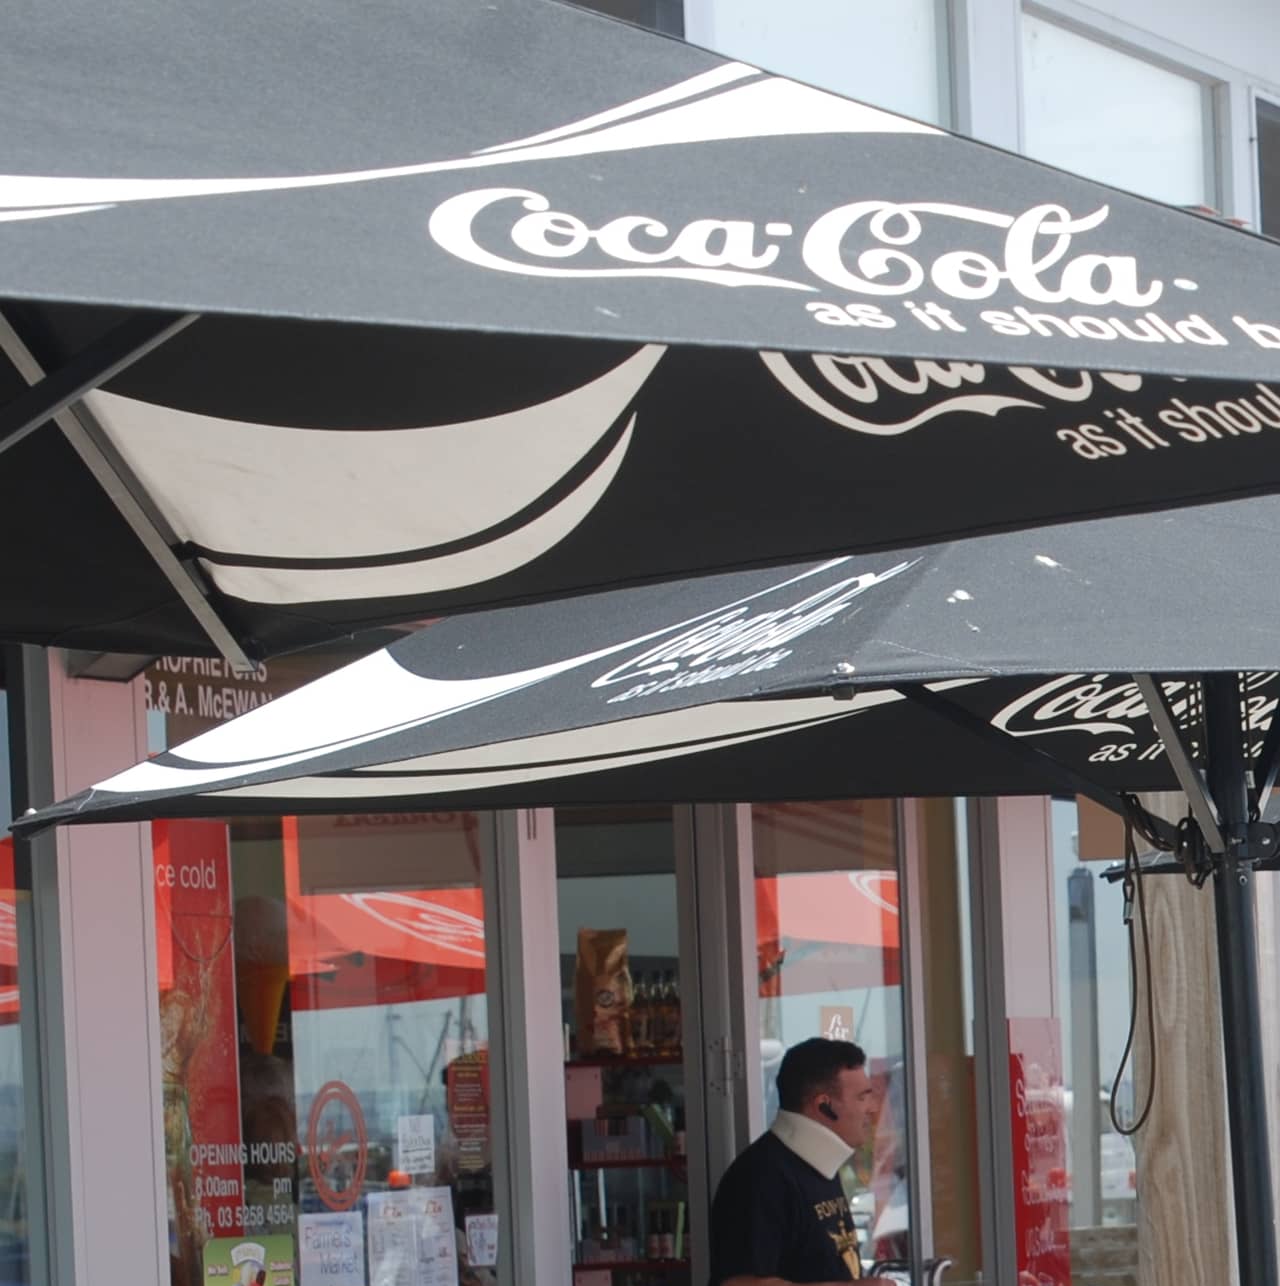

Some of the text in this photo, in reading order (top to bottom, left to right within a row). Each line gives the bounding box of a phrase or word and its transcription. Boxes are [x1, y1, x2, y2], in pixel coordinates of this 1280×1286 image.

[429, 187, 1166, 307] Coca-Cola
[806, 301, 896, 330] as
[903, 300, 967, 334] it
[979, 305, 1228, 347] should
[1056, 428, 1127, 460] as
[1108, 411, 1170, 451] it
[1088, 742, 1137, 763] as
[156, 858, 216, 890] ce cold
[189, 1142, 296, 1167] OPENING HOURS
[218, 1206, 232, 1228] 03
